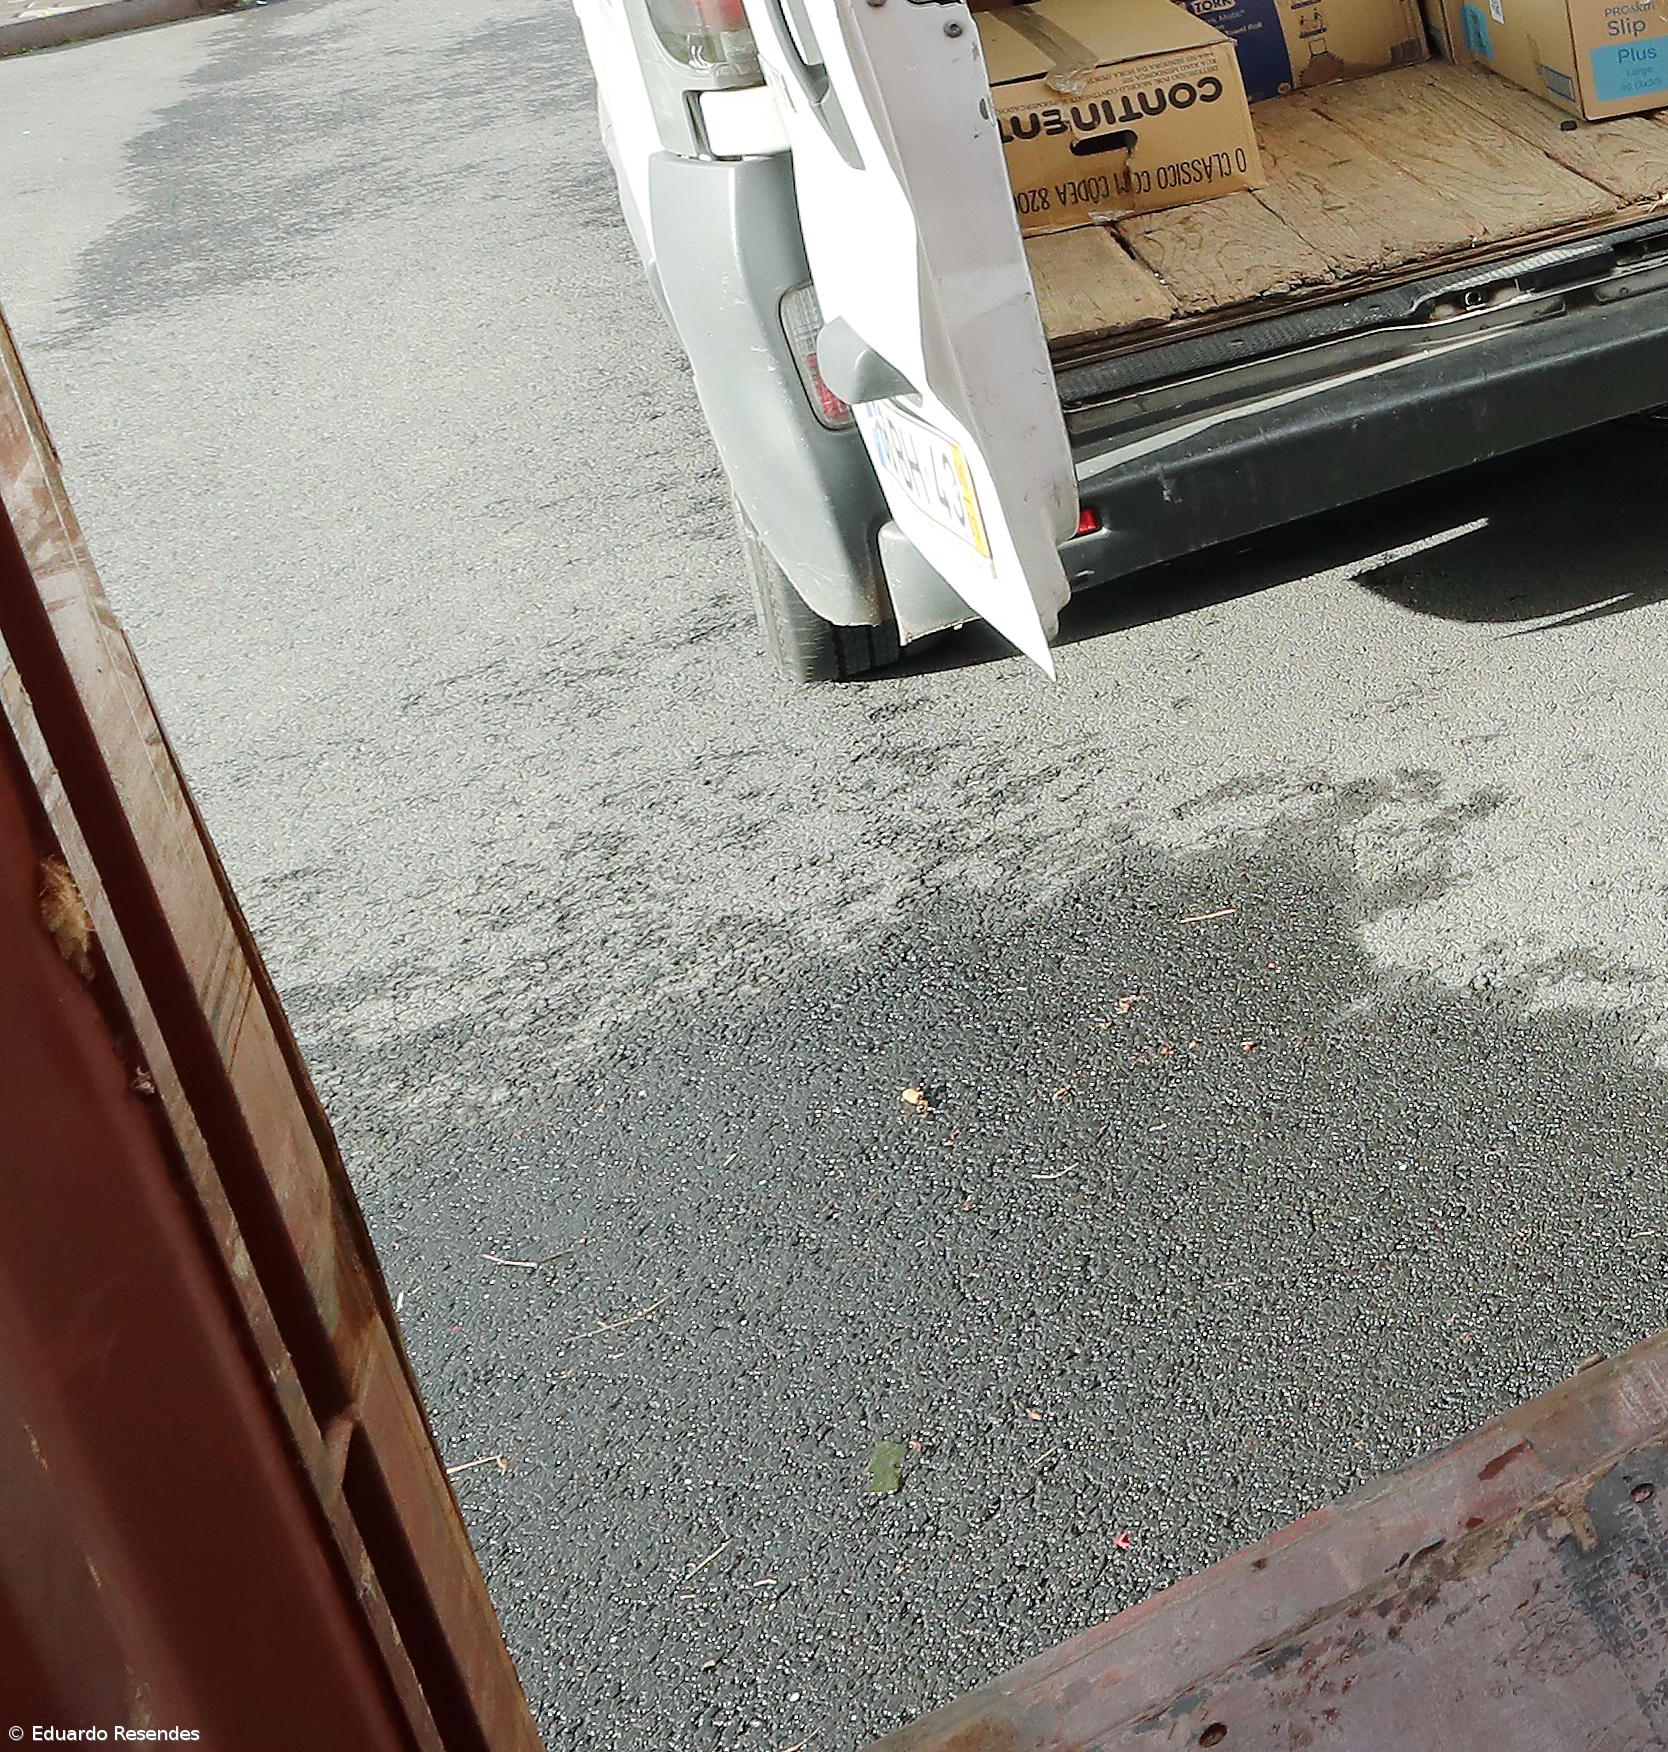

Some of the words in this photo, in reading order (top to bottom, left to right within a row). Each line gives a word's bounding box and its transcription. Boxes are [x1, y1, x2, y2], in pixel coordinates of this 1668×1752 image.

[1607, 18, 1647, 38] Slip
[1617, 45, 1658, 64] Plus
[1156, 150, 1231, 190] CLÁSSICO
[1233, 147, 1247, 173] O
